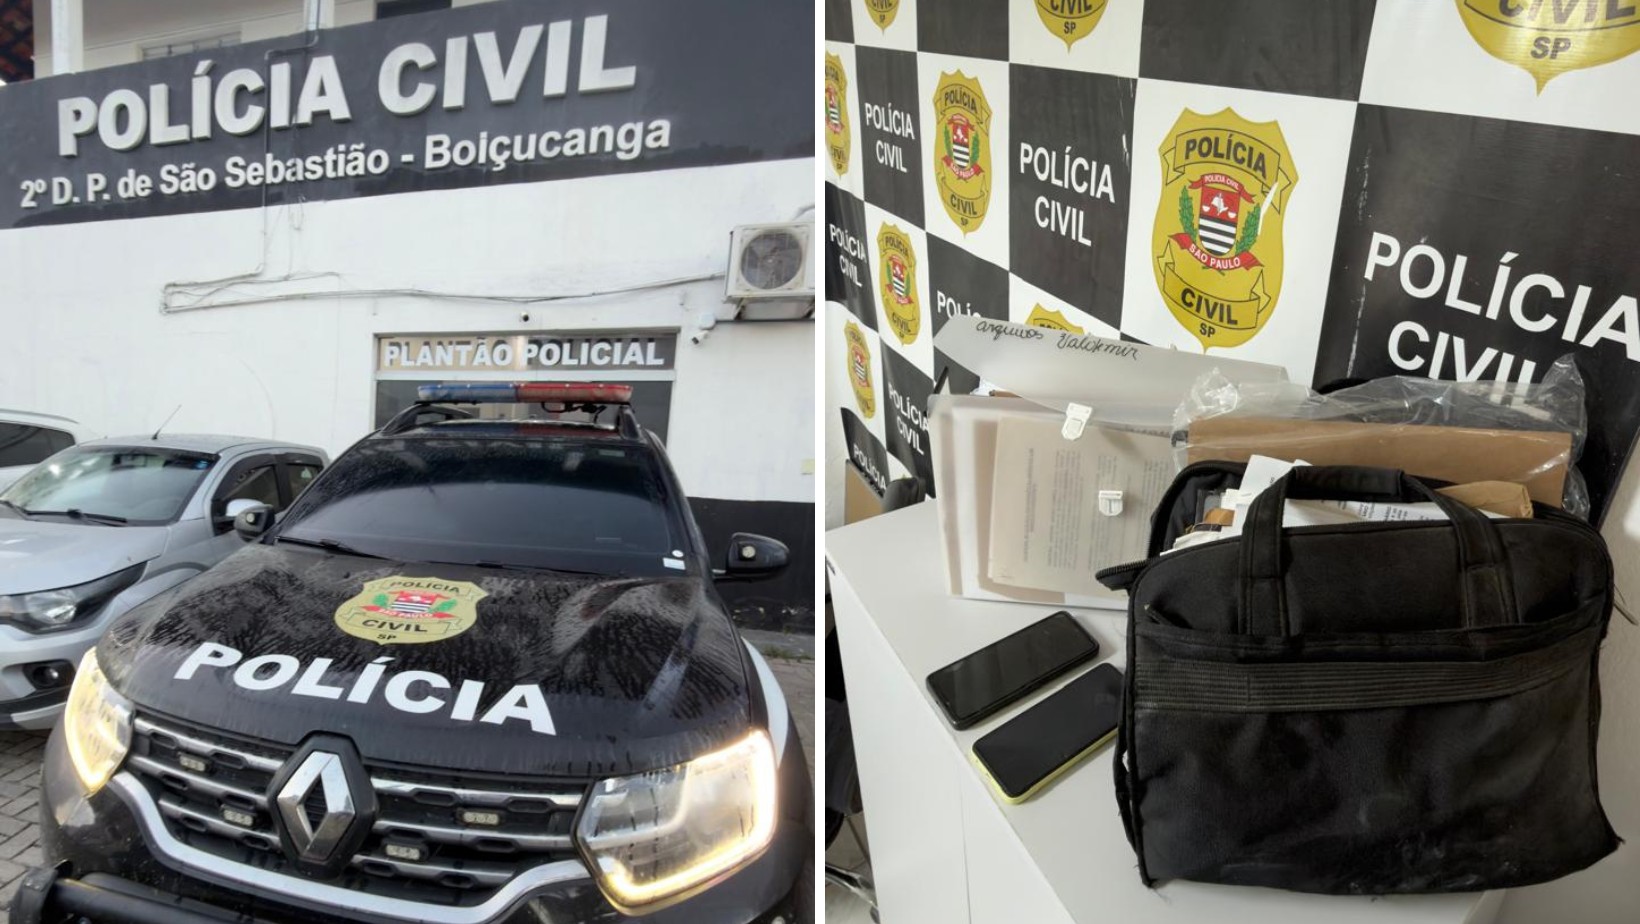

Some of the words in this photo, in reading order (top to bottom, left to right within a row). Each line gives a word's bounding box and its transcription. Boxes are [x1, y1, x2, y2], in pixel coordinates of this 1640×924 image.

[1064, 21, 1076, 34] SP
[1530, 36, 1571, 60] SP
[58, 61, 352, 157] POLÍCIA
[378, 14, 636, 116] CIVIL
[945, 87, 977, 113] POLÍCIA
[864, 102, 915, 140] POLÍCIA
[52, 176, 80, 206] D.
[86, 173, 110, 202] P.
[117, 169, 153, 199] de
[159, 162, 217, 194] São
[225, 142, 390, 188] Sebastião
[424, 118, 671, 172] Boiçucanga
[876, 140, 908, 173] CIVIL
[1019, 142, 1116, 204] POLÍCIA
[1185, 134, 1267, 179] POLÍCIA
[950, 195, 978, 215] CIVIL
[1034, 196, 1092, 247] CIVIL
[829, 223, 867, 264] POLÍCIA
[1210, 257, 1240, 269] PAULO
[1181, 288, 1238, 325] CIVIL
[1364, 231, 1640, 363] POLÍCIA
[1200, 323, 1216, 337] SP
[384, 337, 513, 367] PLANTÃO
[524, 341, 664, 367] POLICIAL
[888, 382, 930, 432] POLÍCIA
[896, 417, 924, 456] CIVIL
[362, 620, 428, 632] CIVIL
[173, 642, 557, 736] POLÍCIA
